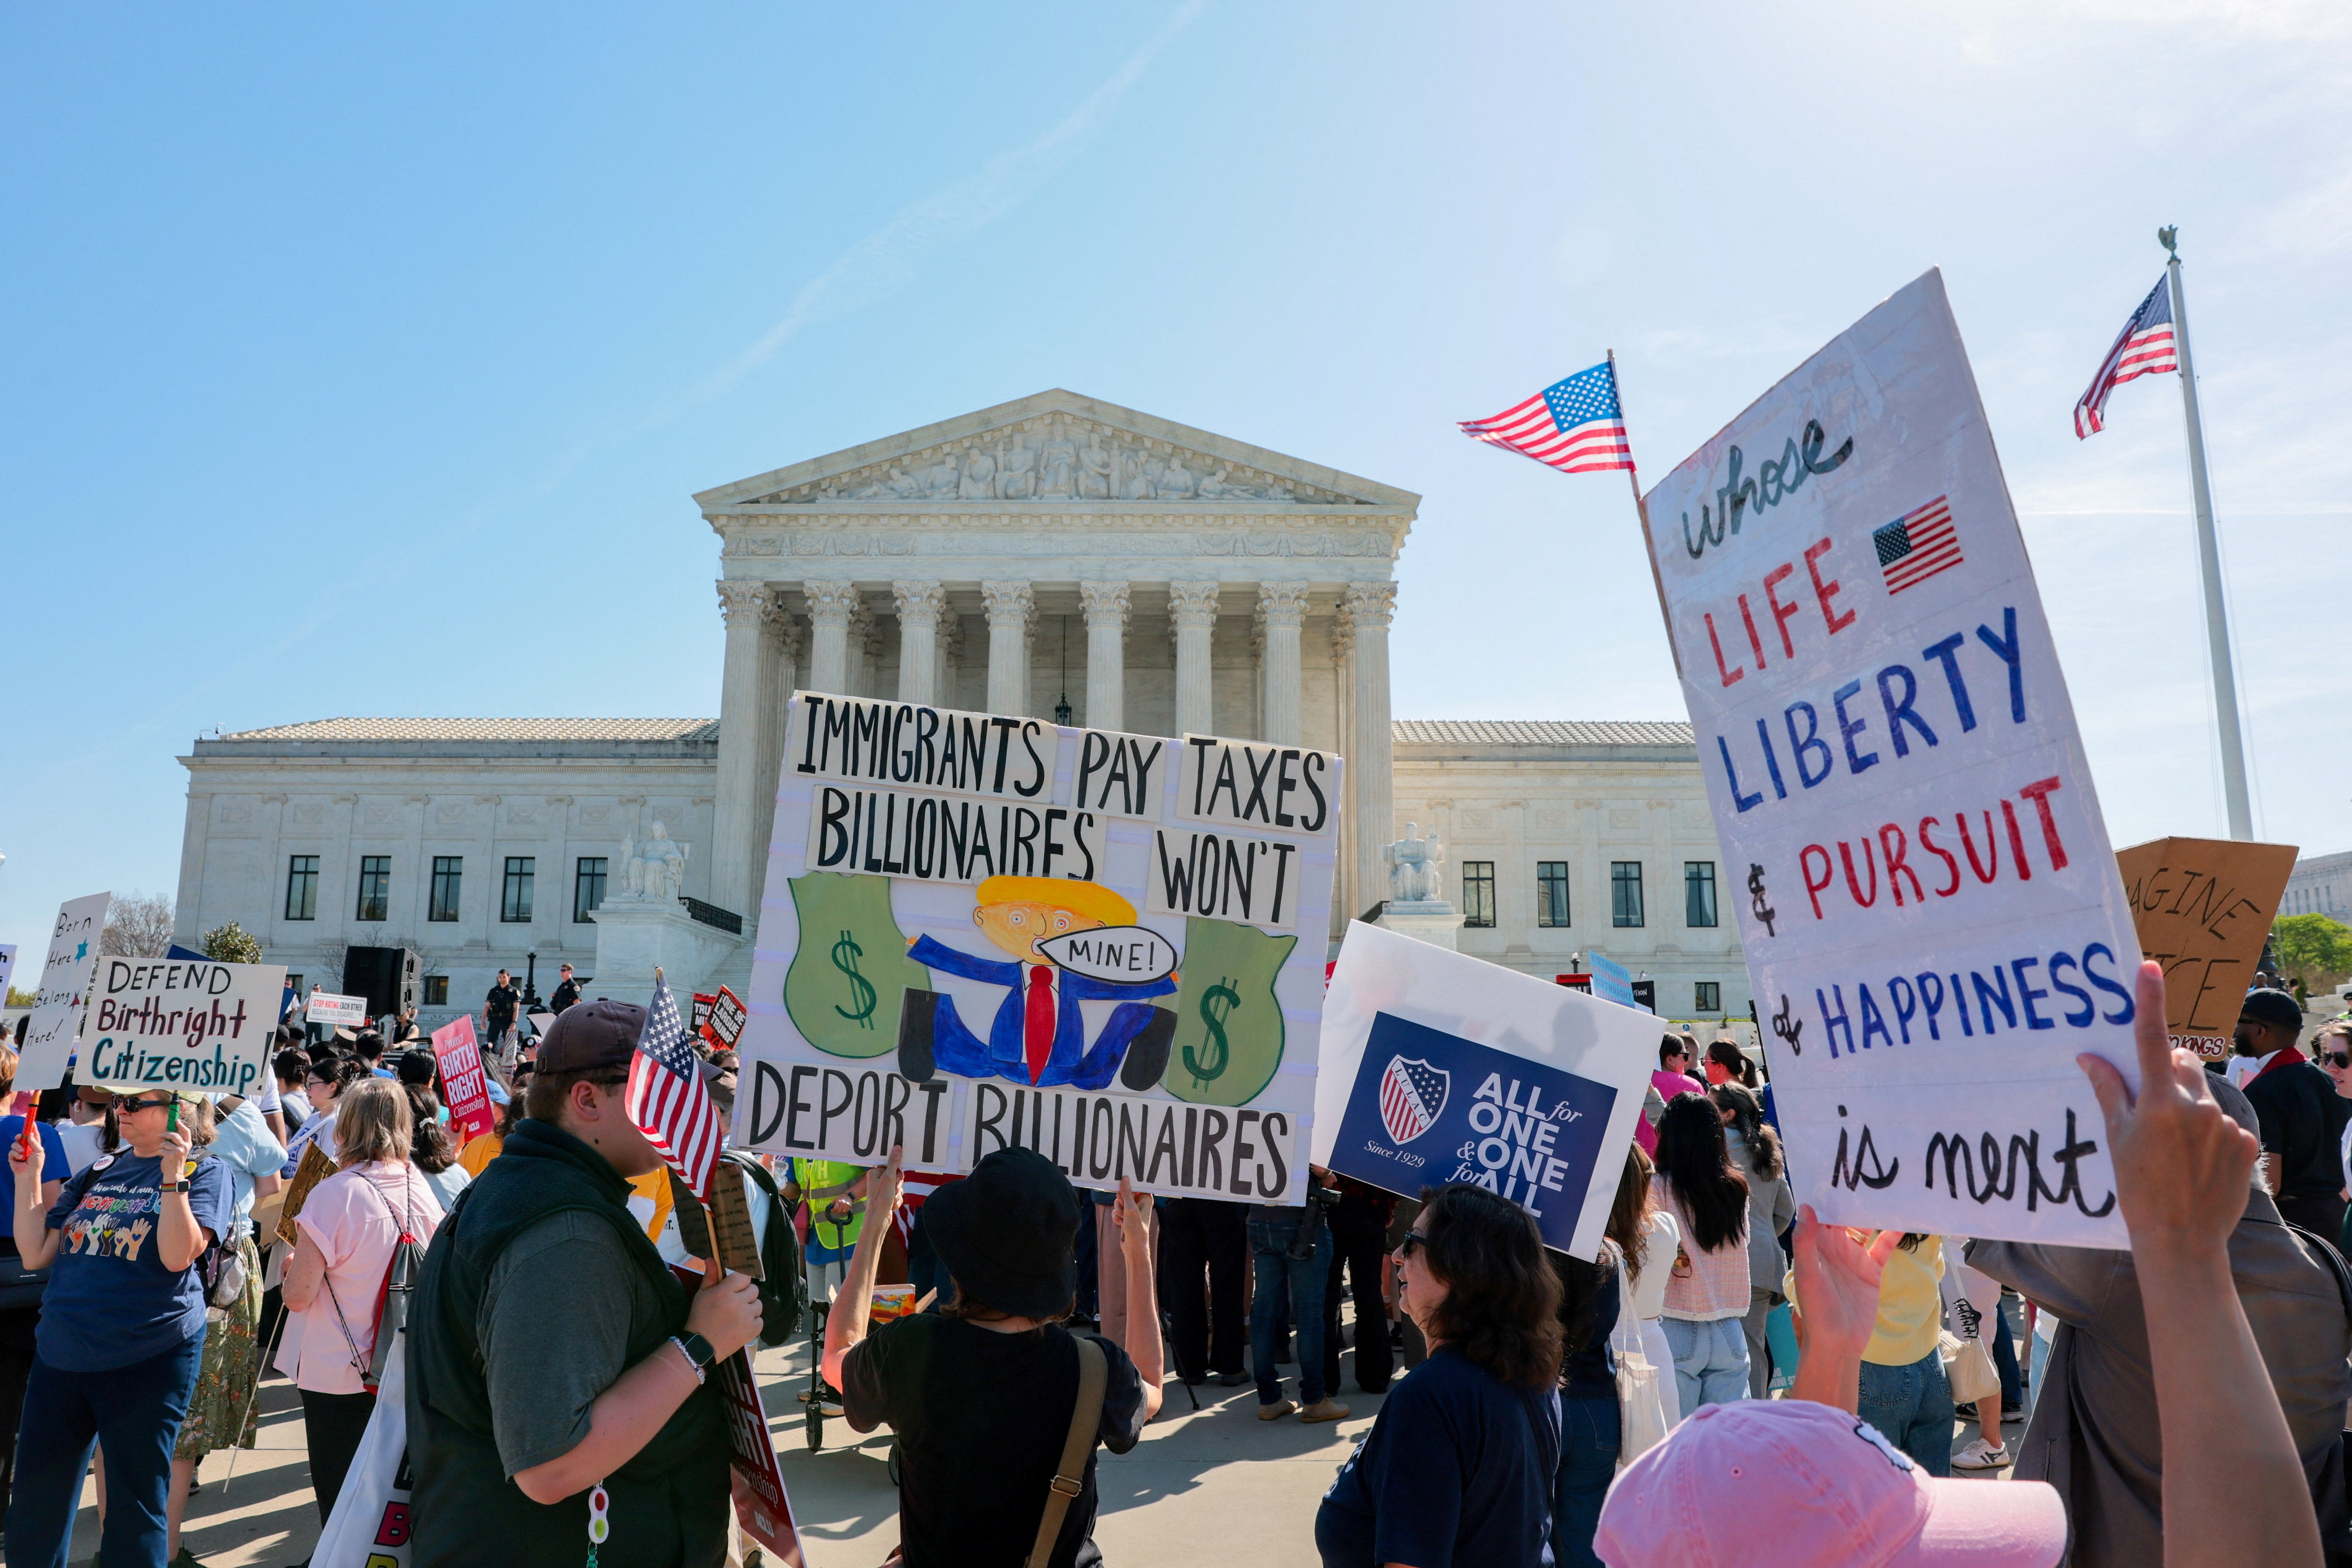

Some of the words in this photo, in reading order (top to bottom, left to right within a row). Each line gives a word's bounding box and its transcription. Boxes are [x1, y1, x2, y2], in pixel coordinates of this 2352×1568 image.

[1682, 418, 1854, 560] whose
[1703, 537, 1856, 688] LIFE
[1717, 606, 2026, 814] LIBERTY
[798, 696, 1046, 797] IMMIGRANTS
[1076, 732, 1167, 815] PAY
[1188, 736, 1327, 832] TAXES
[817, 785, 1095, 882] BILLIONAIRES
[1157, 830, 1295, 924] WON'T
[1799, 775, 2069, 920] PURSUIT
[2125, 868, 2262, 940] AGINE
[56, 912, 91, 937] Born
[46, 951, 71, 970] Here
[1068, 939, 1156, 972] MINE!
[1591, 953, 1628, 979] BIRTHRIGHT
[107, 960, 232, 995] DEFEND
[1592, 965, 1631, 989] CITIZENSHIP
[1594, 976, 1632, 1002] BIRTHRIGHT
[34, 988, 70, 1008] Belong
[313, 999, 324, 1008] STOP
[325, 1001, 339, 1009] HATING
[340, 1002, 350, 1010] EACH
[351, 1003, 363, 1012] OTHER
[719, 994, 736, 1016] ¡QUE
[734, 1010, 746, 1025] SE
[1816, 942, 2135, 1060] HAPPINESS
[27, 1018, 64, 1047] Here!
[98, 995, 247, 1048] Birthright
[710, 1013, 734, 1043] TRUMP
[714, 1002, 740, 1036] LARGUE
[444, 1034, 464, 1051] Protect
[2181, 1036, 2224, 1055] KINGS
[92, 1031, 275, 1095] Citizenship!
[440, 1042, 477, 1080] BIRTH
[446, 1068, 482, 1106] RIGHT
[1394, 1067, 1428, 1123] LULAC
[1472, 1072, 1548, 1122] ALL
[1545, 1101, 1583, 1123] for
[454, 1096, 485, 1119] Citizenship
[468, 1121, 479, 1132] ACLU
[749, 1059, 948, 1164] DEPORT
[973, 1082, 1288, 1200] BILLIONAIRES
[1468, 1101, 1560, 1157] ONE
[1364, 1140, 1393, 1159] Since
[1394, 1149, 1425, 1168] 1929
[1457, 1141, 1475, 1161] &
[1477, 1137, 1569, 1192] ONE
[1831, 1104, 1899, 1192] is
[1924, 1106, 2117, 1218] next
[1445, 1162, 1486, 1184] for
[754, 1510, 775, 1538] ACLU
